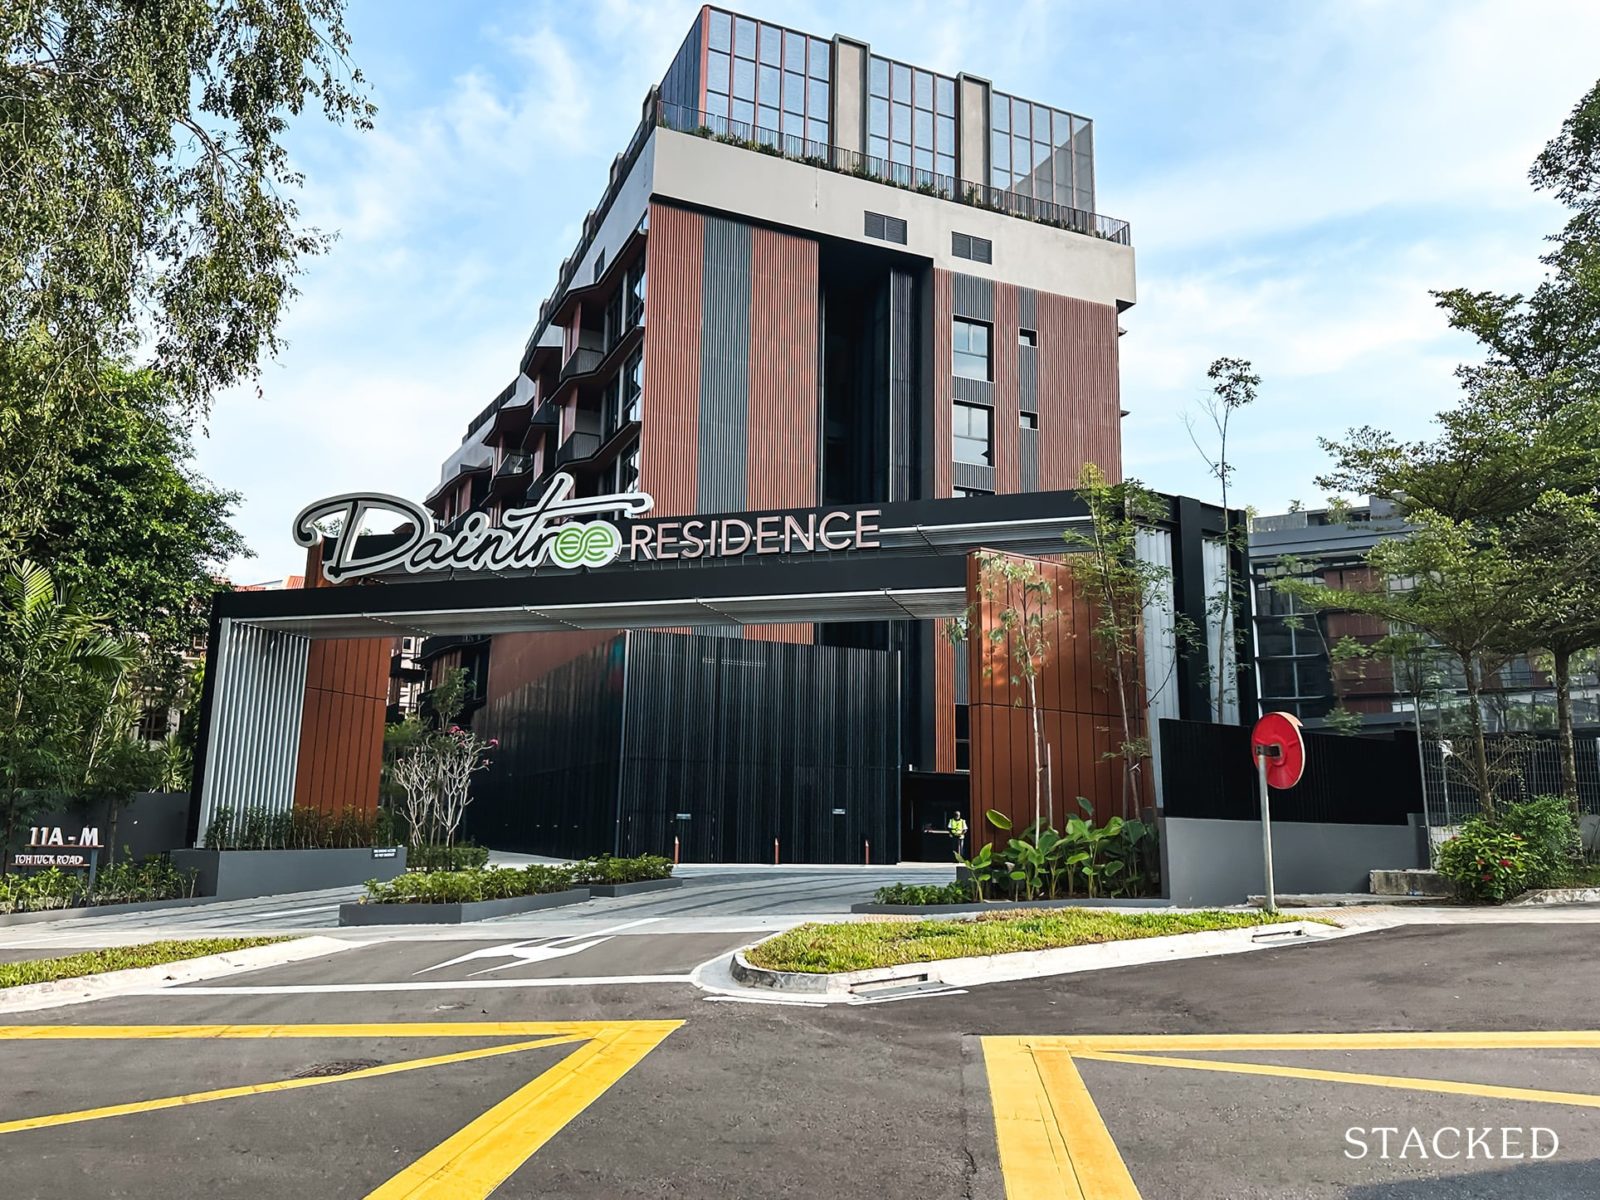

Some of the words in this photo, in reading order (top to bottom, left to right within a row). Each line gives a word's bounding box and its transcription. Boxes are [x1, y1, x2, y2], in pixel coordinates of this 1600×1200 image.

[293, 472, 654, 584] Daintree
[630, 508, 882, 562] RESIDENCE
[30, 827, 63, 846] 11A
[80, 827, 99, 846] M
[15, 854, 33, 864] TOH
[34, 854, 55, 864] TUCK
[56, 854, 84, 864] ROAD
